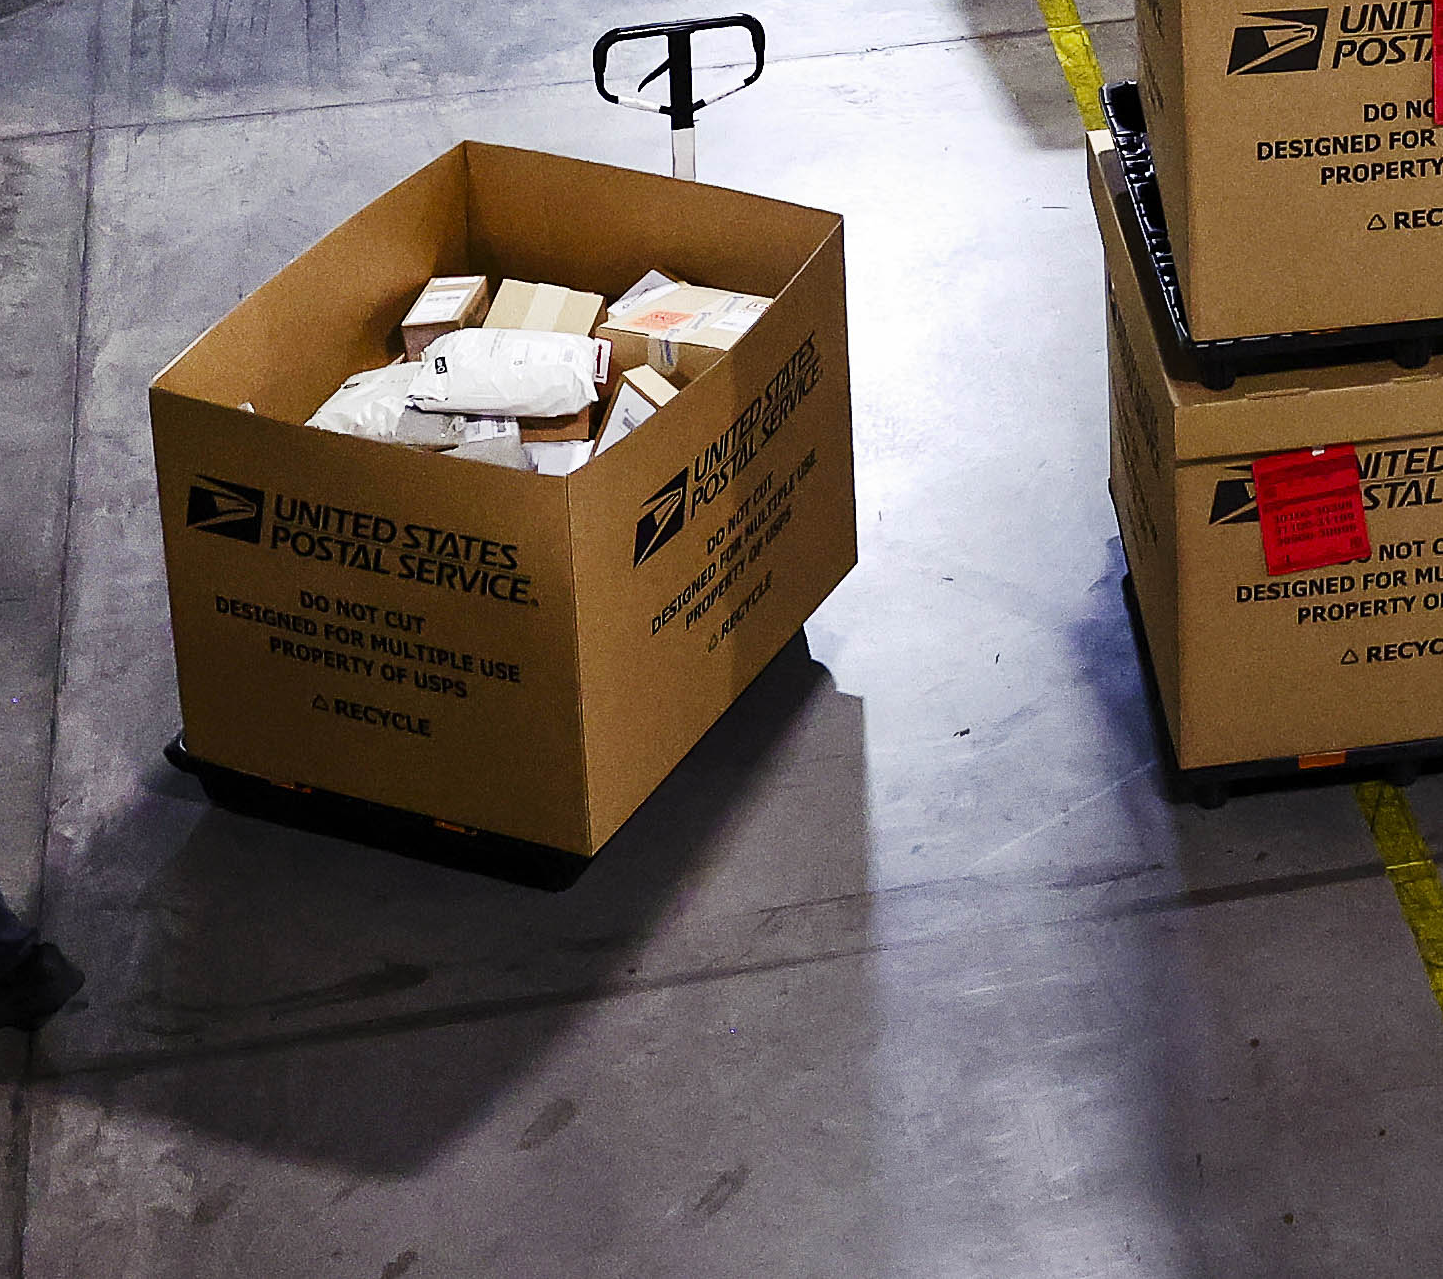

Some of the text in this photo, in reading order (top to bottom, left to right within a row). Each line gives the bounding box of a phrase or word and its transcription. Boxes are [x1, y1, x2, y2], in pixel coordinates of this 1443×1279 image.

[1340, 0, 1433, 34] UNIT
[1332, 33, 1433, 69] POST
[1361, 99, 1435, 124] DO NO
[1255, 131, 1379, 162] DESIGNED
[1387, 126, 1435, 150] FOR
[1319, 157, 1442, 187] PROPERTY
[275, 493, 516, 573] UNITED STATES
[269, 523, 532, 608] POSTAL SERVICE
[299, 589, 426, 636] DO NOT CUT
[214, 593, 521, 685] DESIGNED FOR MULTIPLE USE
[269, 635, 467, 700] PROPERTY OF USPS
[334, 696, 431, 738] RECYCLE
